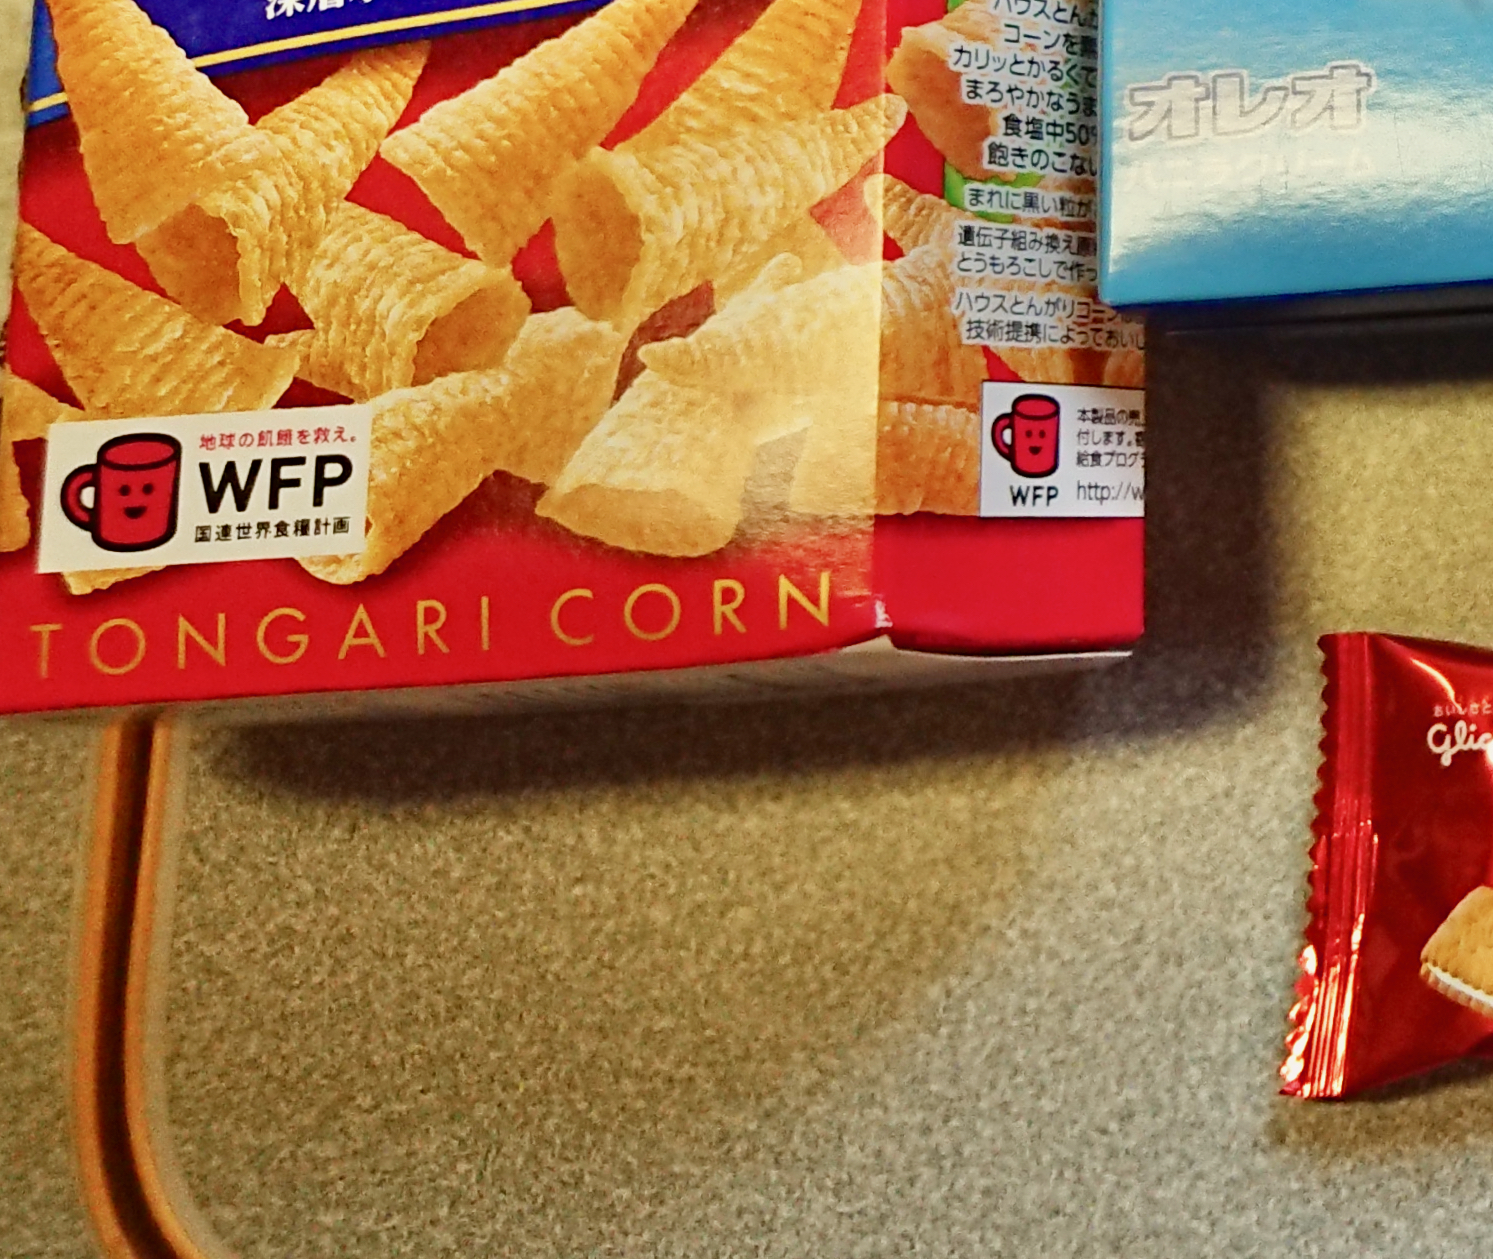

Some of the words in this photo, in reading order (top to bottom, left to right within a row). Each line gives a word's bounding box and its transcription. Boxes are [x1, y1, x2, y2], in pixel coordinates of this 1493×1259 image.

[1126, 63, 1374, 142] オレオ
[1077, 408, 1146, 427] 本製品の売
[199, 425, 360, 452] 地球の飢餓を救え。
[199, 453, 354, 516] WFP
[1010, 484, 1059, 507] WFP
[194, 515, 351, 545] 国連世界食糧計画
[31, 595, 491, 679] TONGARI
[550, 572, 834, 648] CORN
